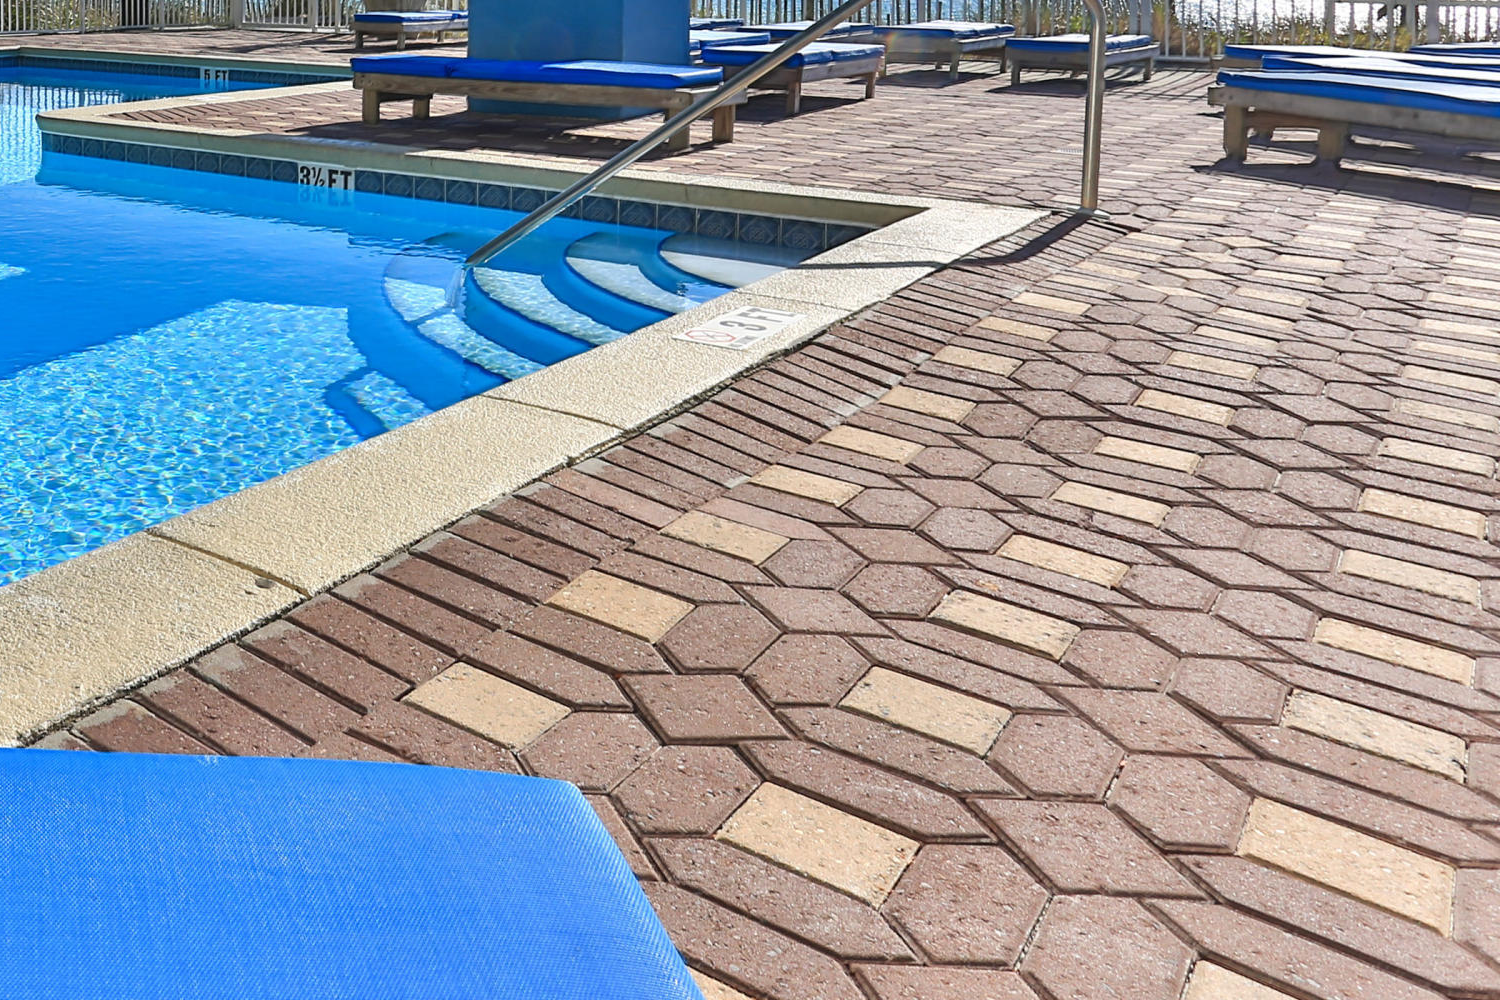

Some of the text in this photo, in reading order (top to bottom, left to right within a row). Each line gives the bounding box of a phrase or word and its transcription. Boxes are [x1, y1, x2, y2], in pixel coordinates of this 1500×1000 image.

[215, 70, 228, 80] FT
[328, 169, 352, 190] FT
[719, 307, 796, 331] 3 FT
